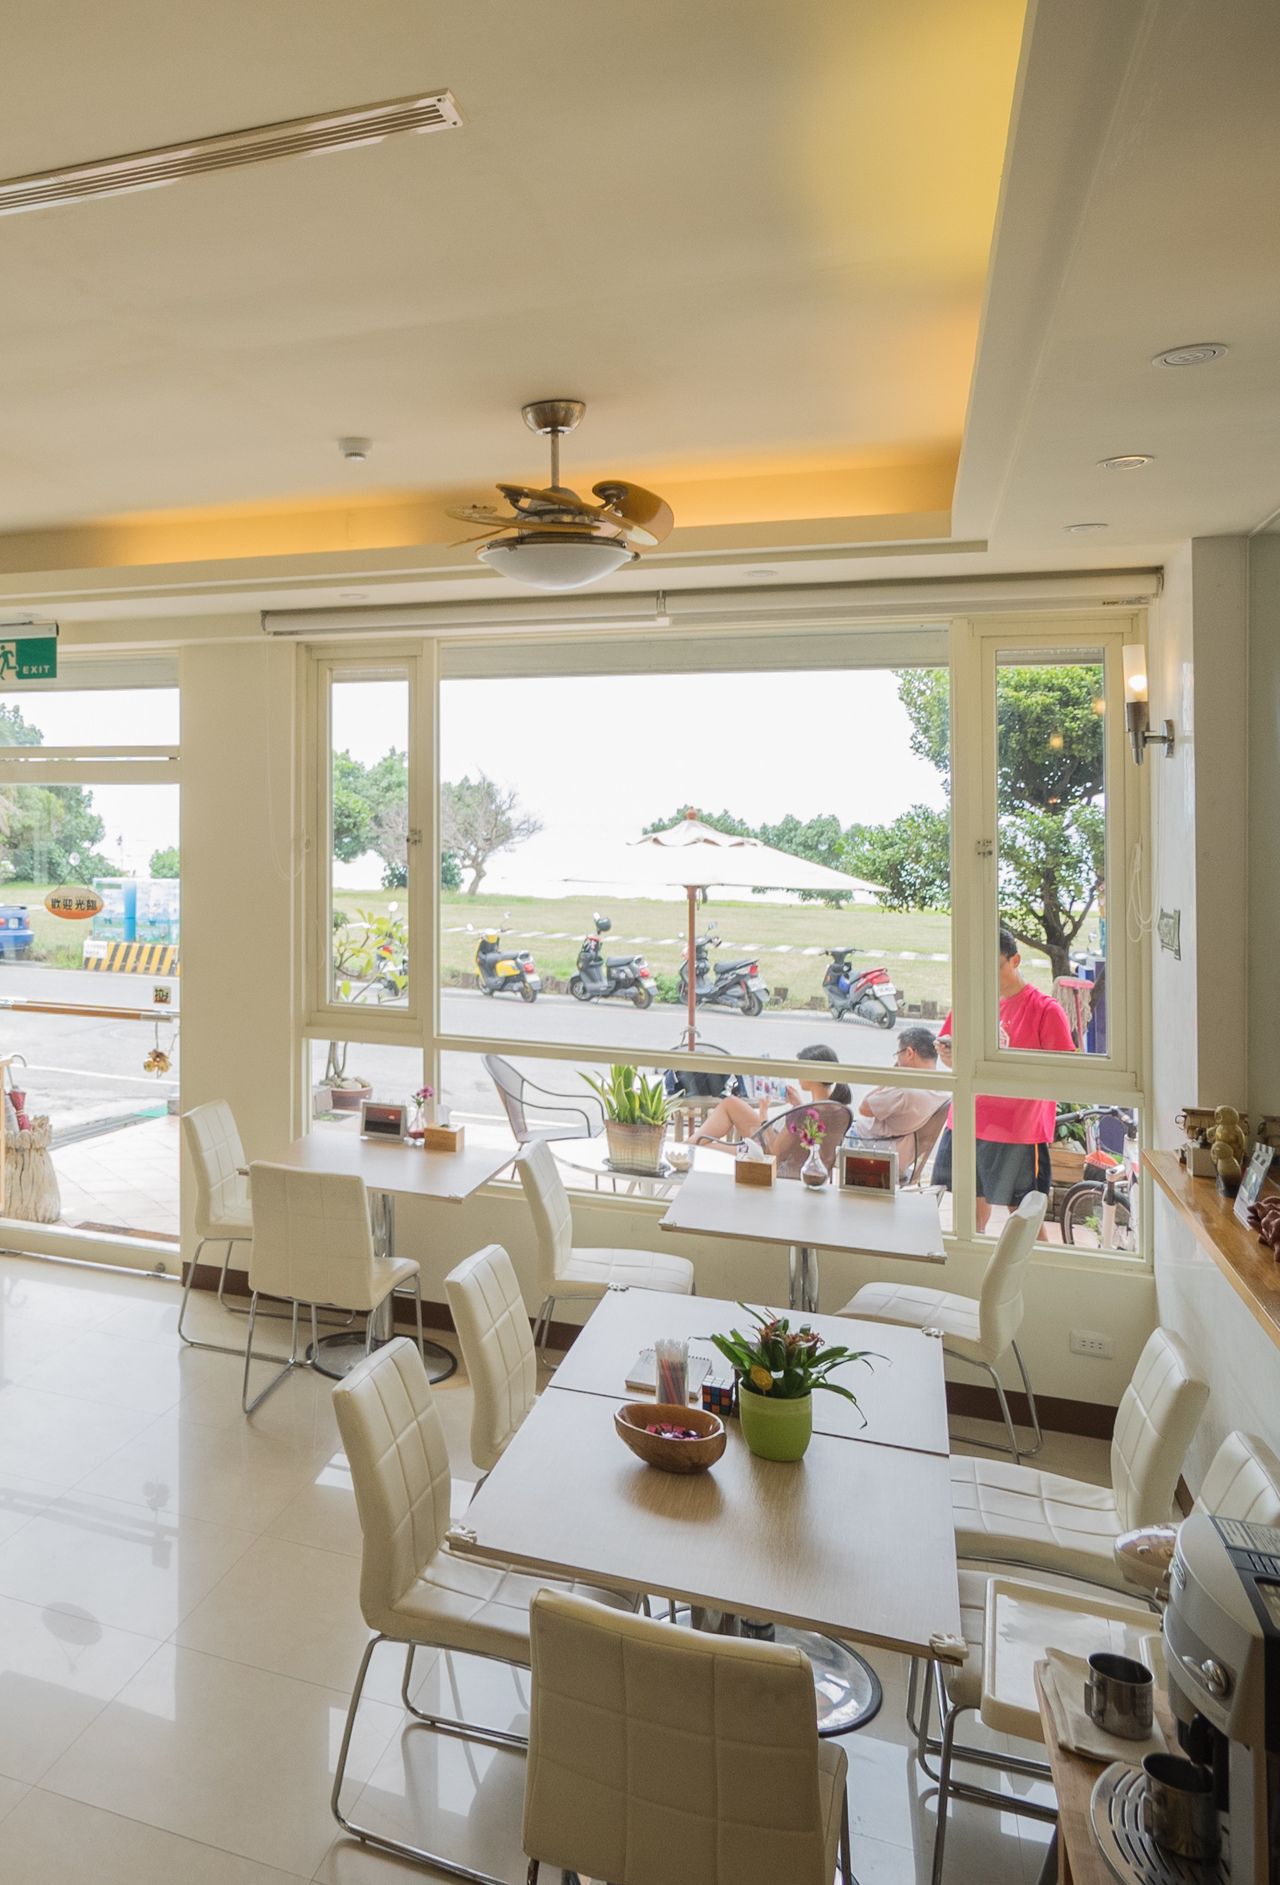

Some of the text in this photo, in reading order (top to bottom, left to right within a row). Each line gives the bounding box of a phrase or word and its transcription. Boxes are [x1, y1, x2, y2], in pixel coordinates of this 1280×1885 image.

[23, 665, 50, 675] EXIT
[51, 898, 98, 911] 歡迎光臨
